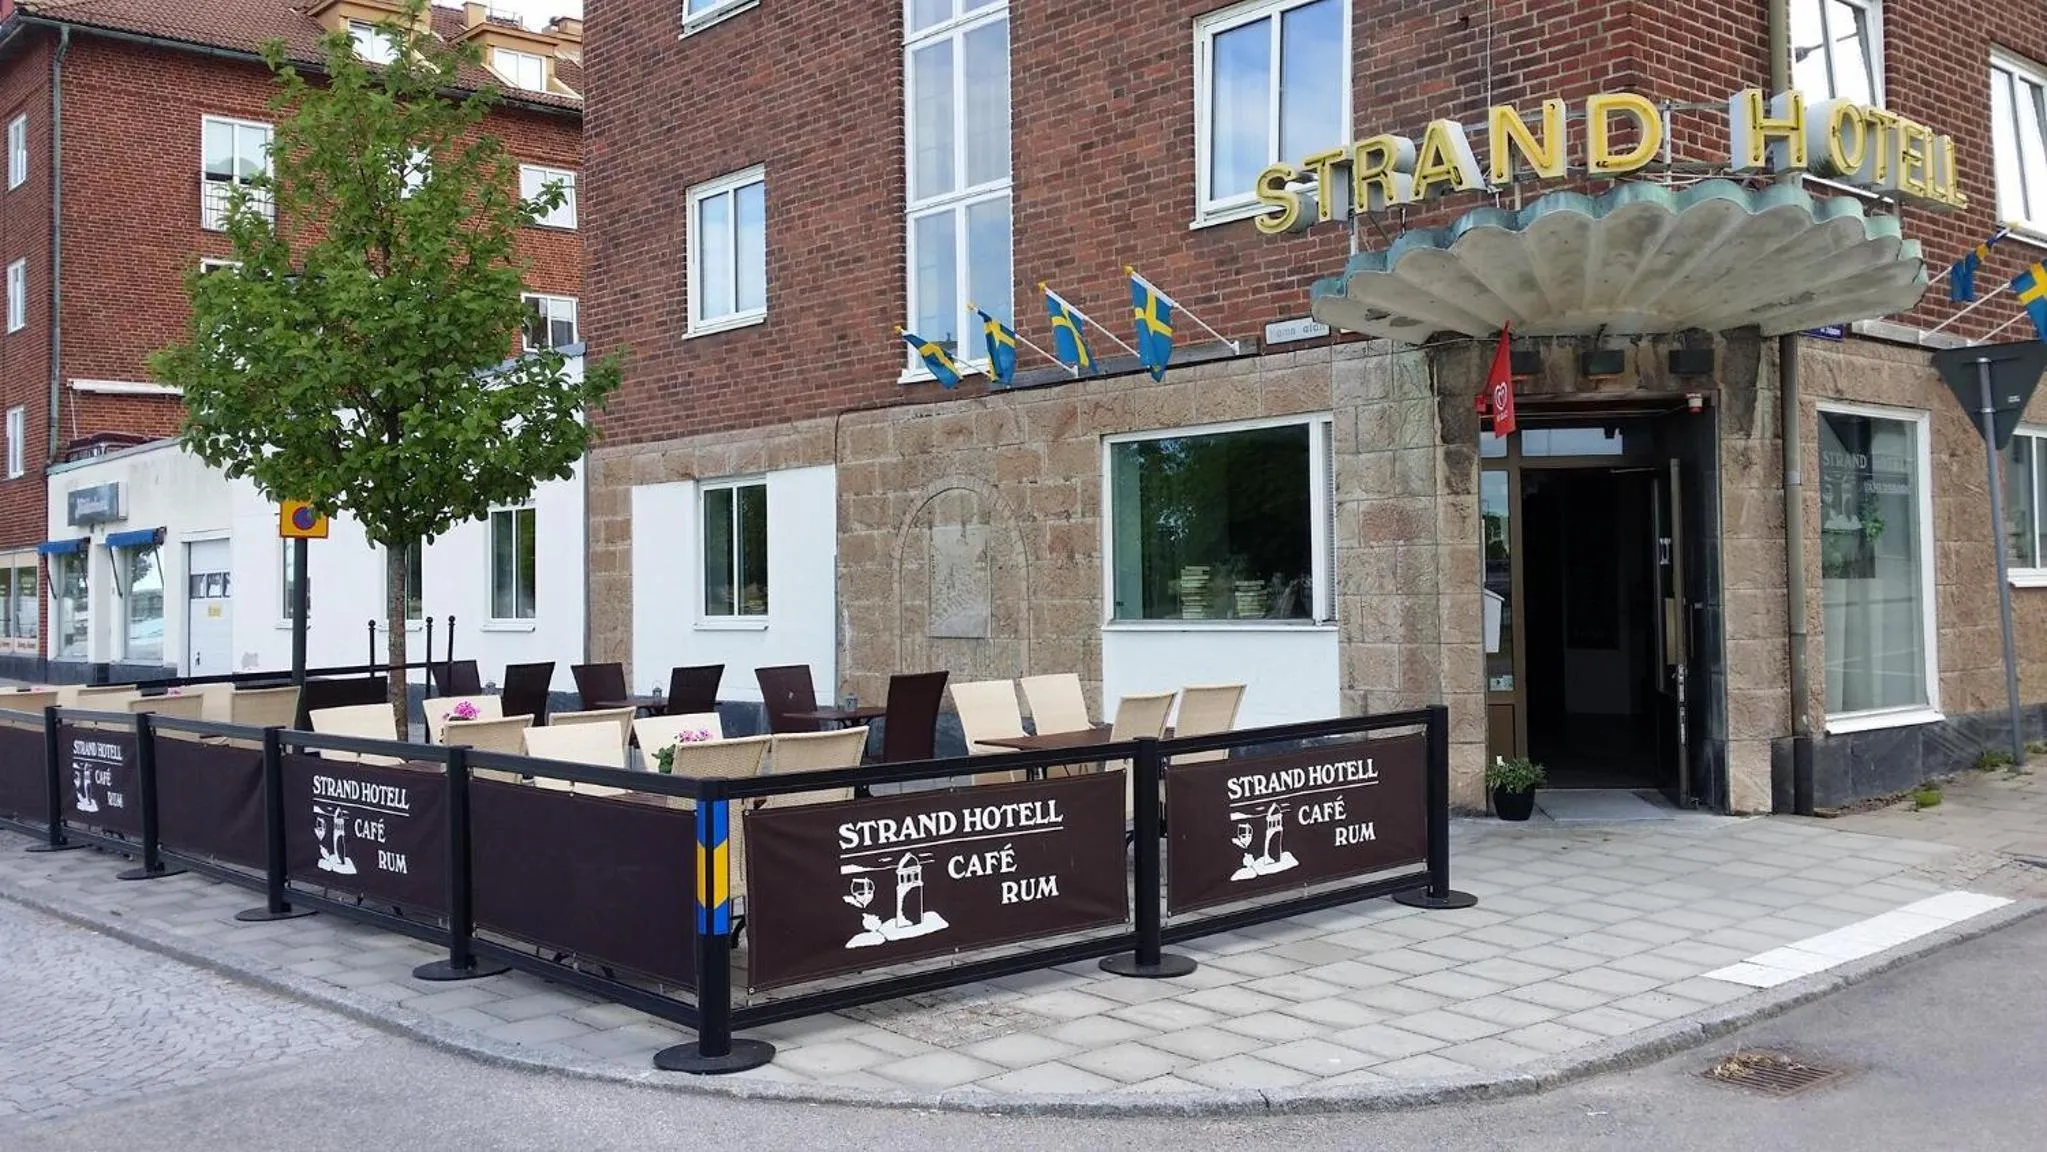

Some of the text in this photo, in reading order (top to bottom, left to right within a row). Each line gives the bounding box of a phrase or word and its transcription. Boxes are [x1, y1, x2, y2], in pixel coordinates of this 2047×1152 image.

[1254, 88, 1968, 235] STRAND HOTELL
[1821, 450, 1867, 469] STRAND
[73, 740, 122, 760] STRAND HOTELL
[95, 768, 112, 787] CAFÉ
[1227, 758, 1379, 800] STRAND HOTELL
[107, 791, 123, 808] RUM
[313, 775, 410, 809] STRAND HOTELL
[1298, 795, 1347, 825] CAFÉ
[354, 818, 386, 843] CAFÉ
[838, 800, 1064, 850] STRAND HOTELL
[1335, 822, 1376, 847] RUM
[378, 849, 408, 874] RUM
[948, 843, 1019, 879] CAFÉ
[1001, 875, 1059, 904] RUM
